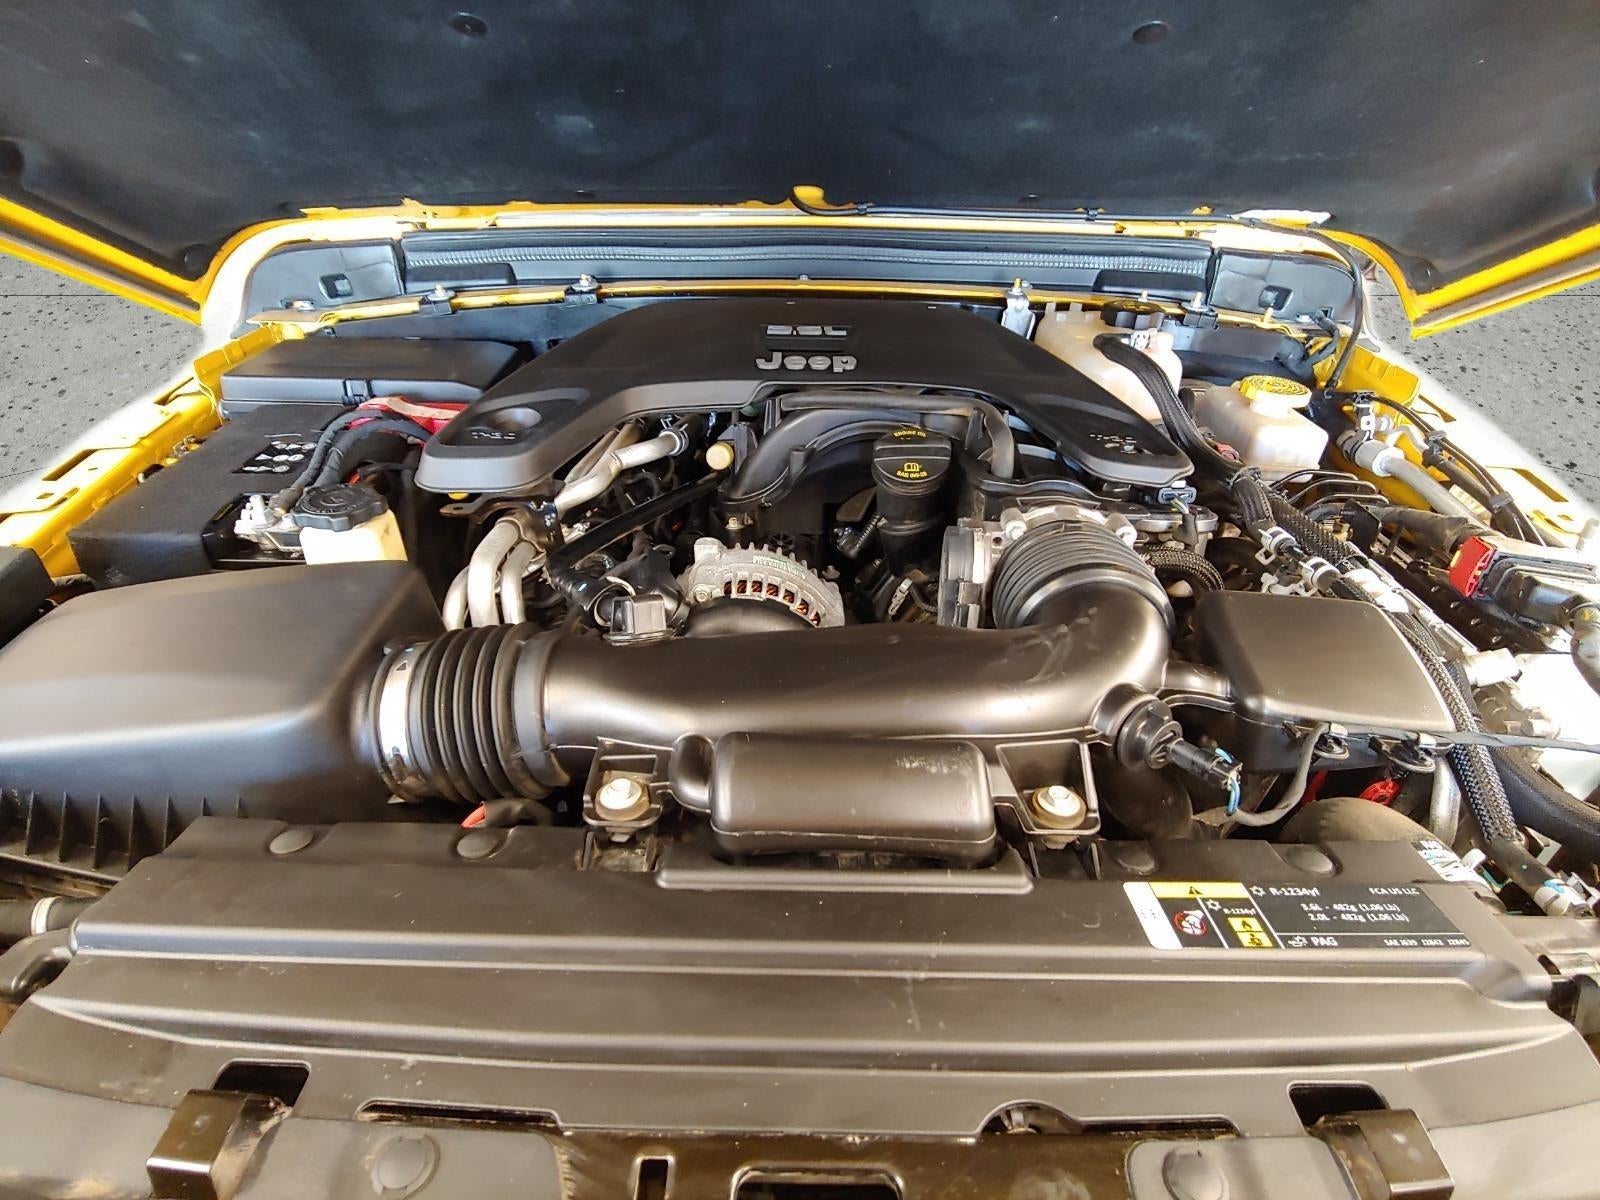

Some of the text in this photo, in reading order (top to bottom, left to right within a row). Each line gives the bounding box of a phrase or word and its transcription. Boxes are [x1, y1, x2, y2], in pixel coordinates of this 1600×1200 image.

[756, 352, 857, 372] Jeep
[1268, 887, 1320, 897] R-1234yf
[1368, 887, 1389, 895] FCA
[1310, 936, 1338, 946] PAG
